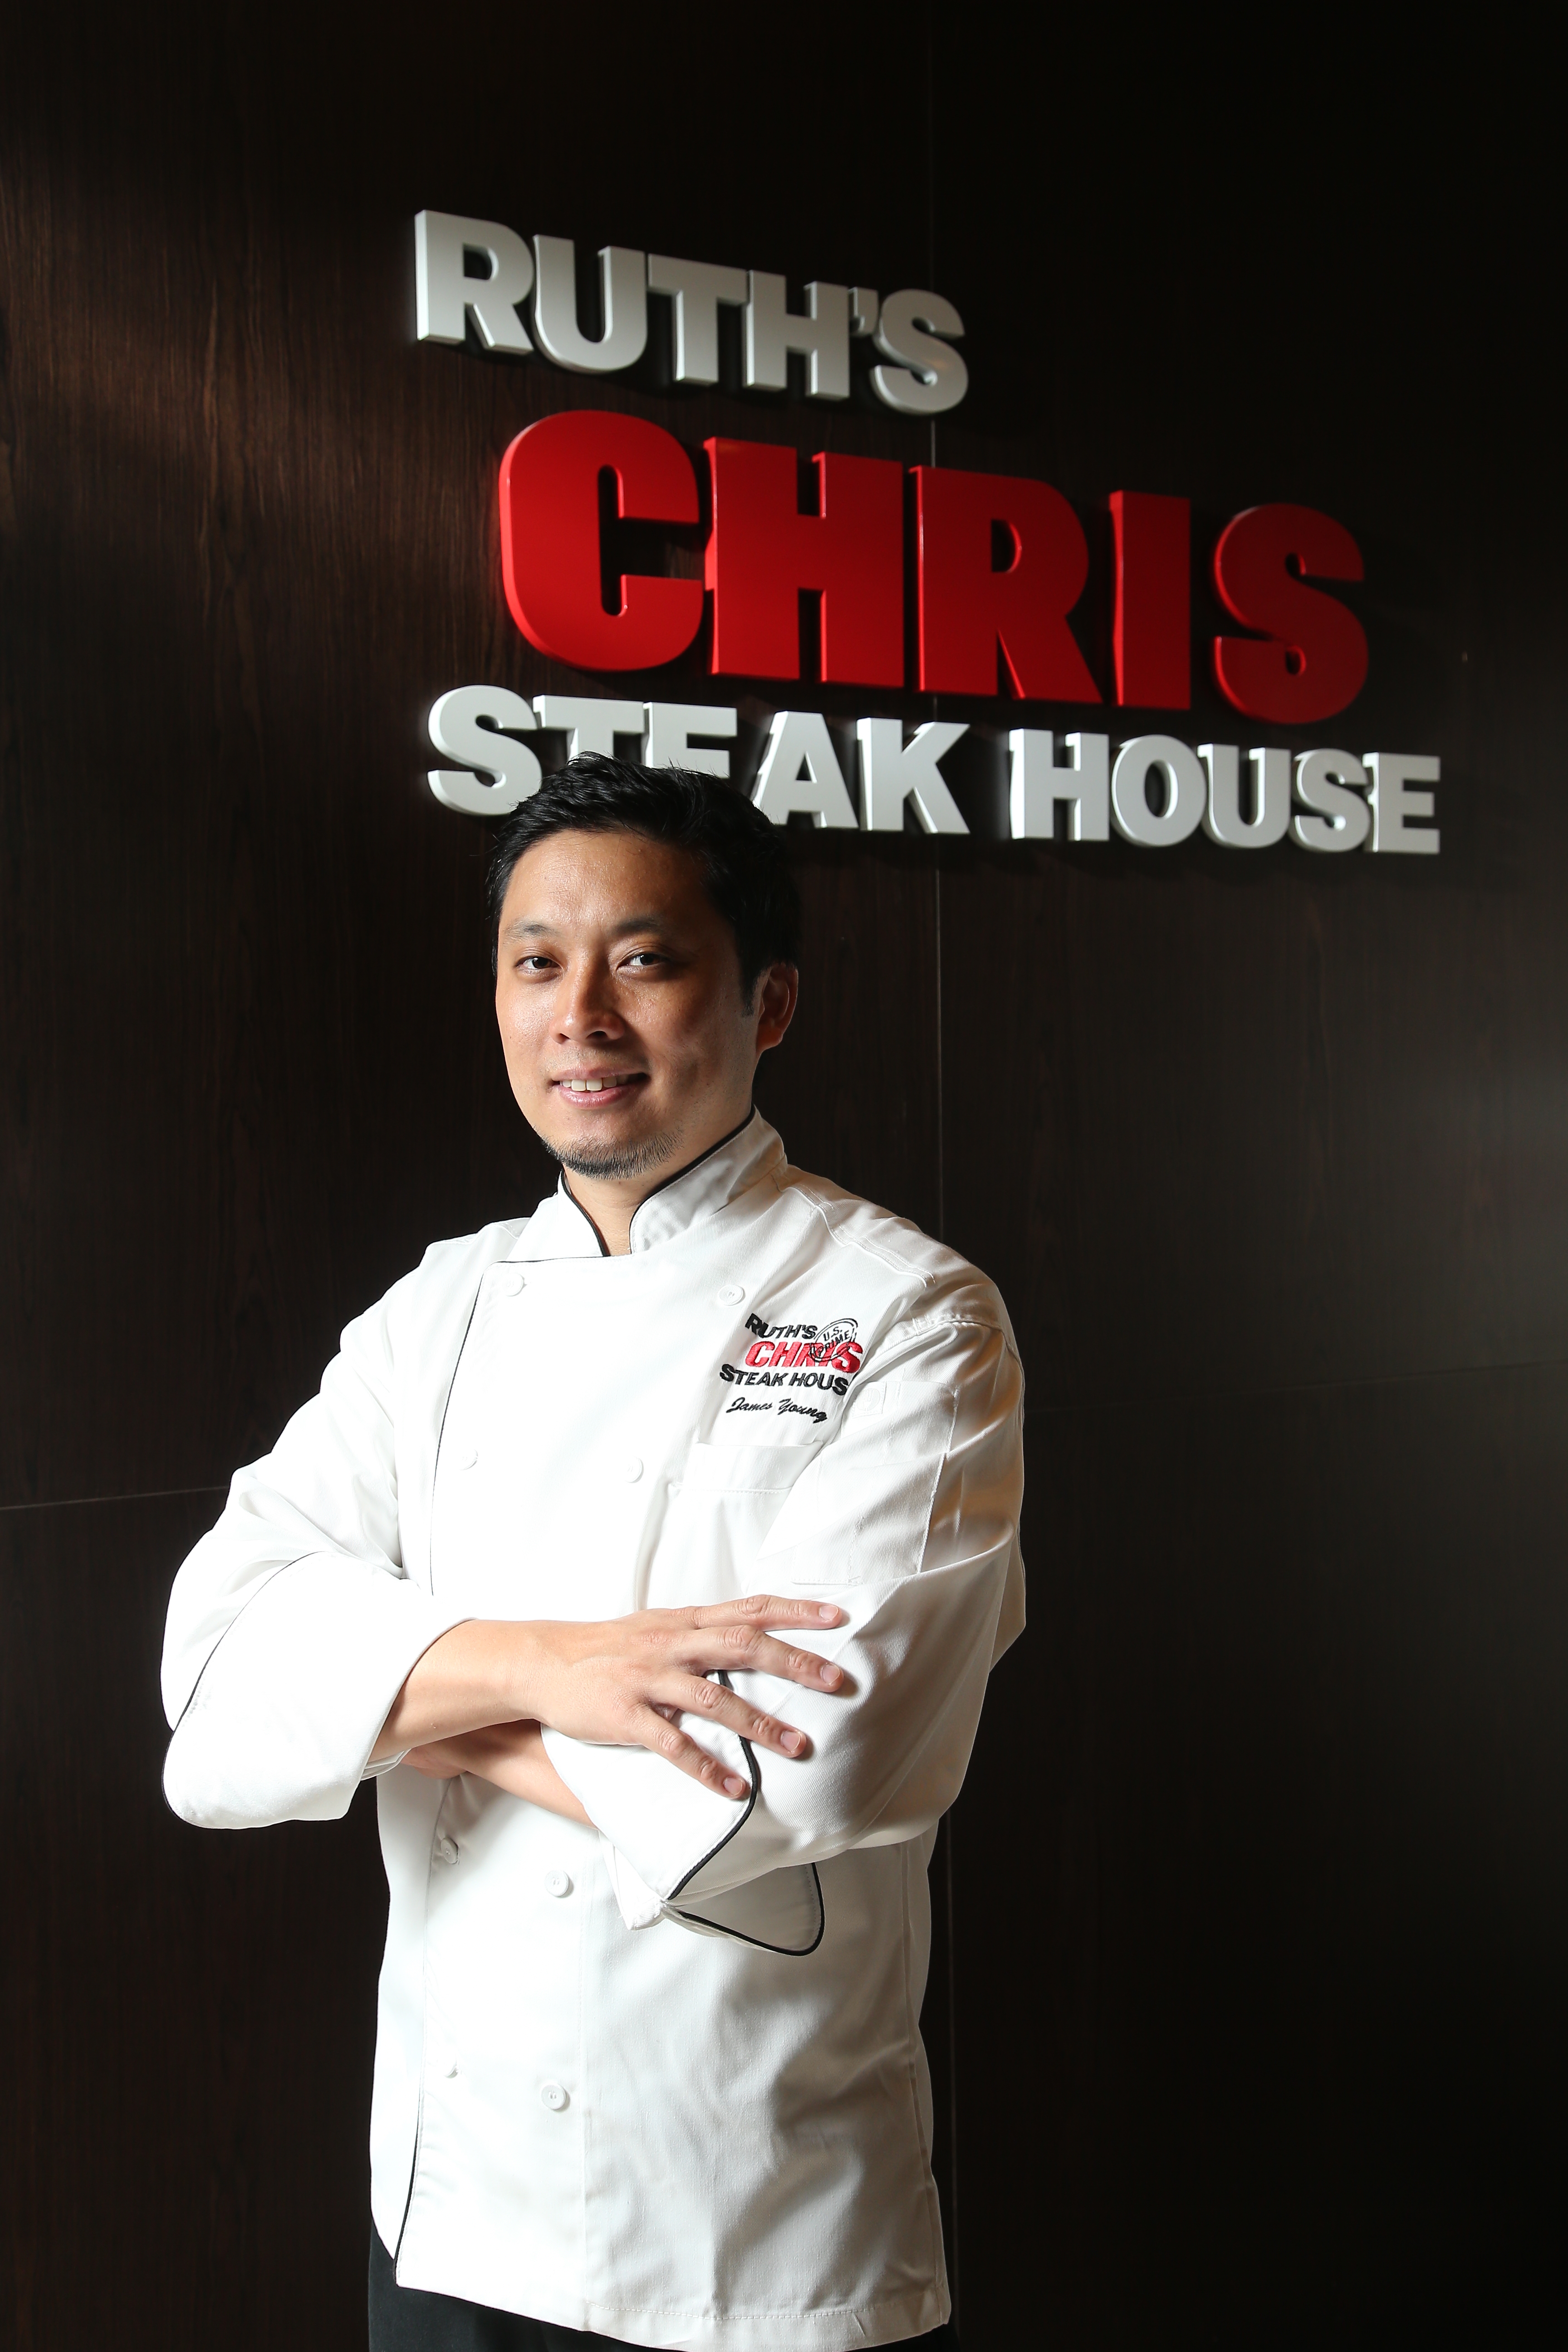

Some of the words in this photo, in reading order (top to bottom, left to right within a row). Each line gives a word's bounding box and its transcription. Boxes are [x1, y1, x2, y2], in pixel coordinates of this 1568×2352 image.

[415, 210, 968, 415] RUTH'S
[499, 410, 1368, 724] CHRIS
[1009, 728, 1440, 854] HOUSE
[745, 1313, 818, 1339] RUTH'S
[823, 1326, 843, 1341] U.S.
[745, 1341, 863, 1373] CHRIS
[720, 1363, 788, 1387] STEAK
[788, 1372, 849, 1396] HOUS
[726, 1397, 773, 1413] James
[777, 1398, 828, 1424] Young
